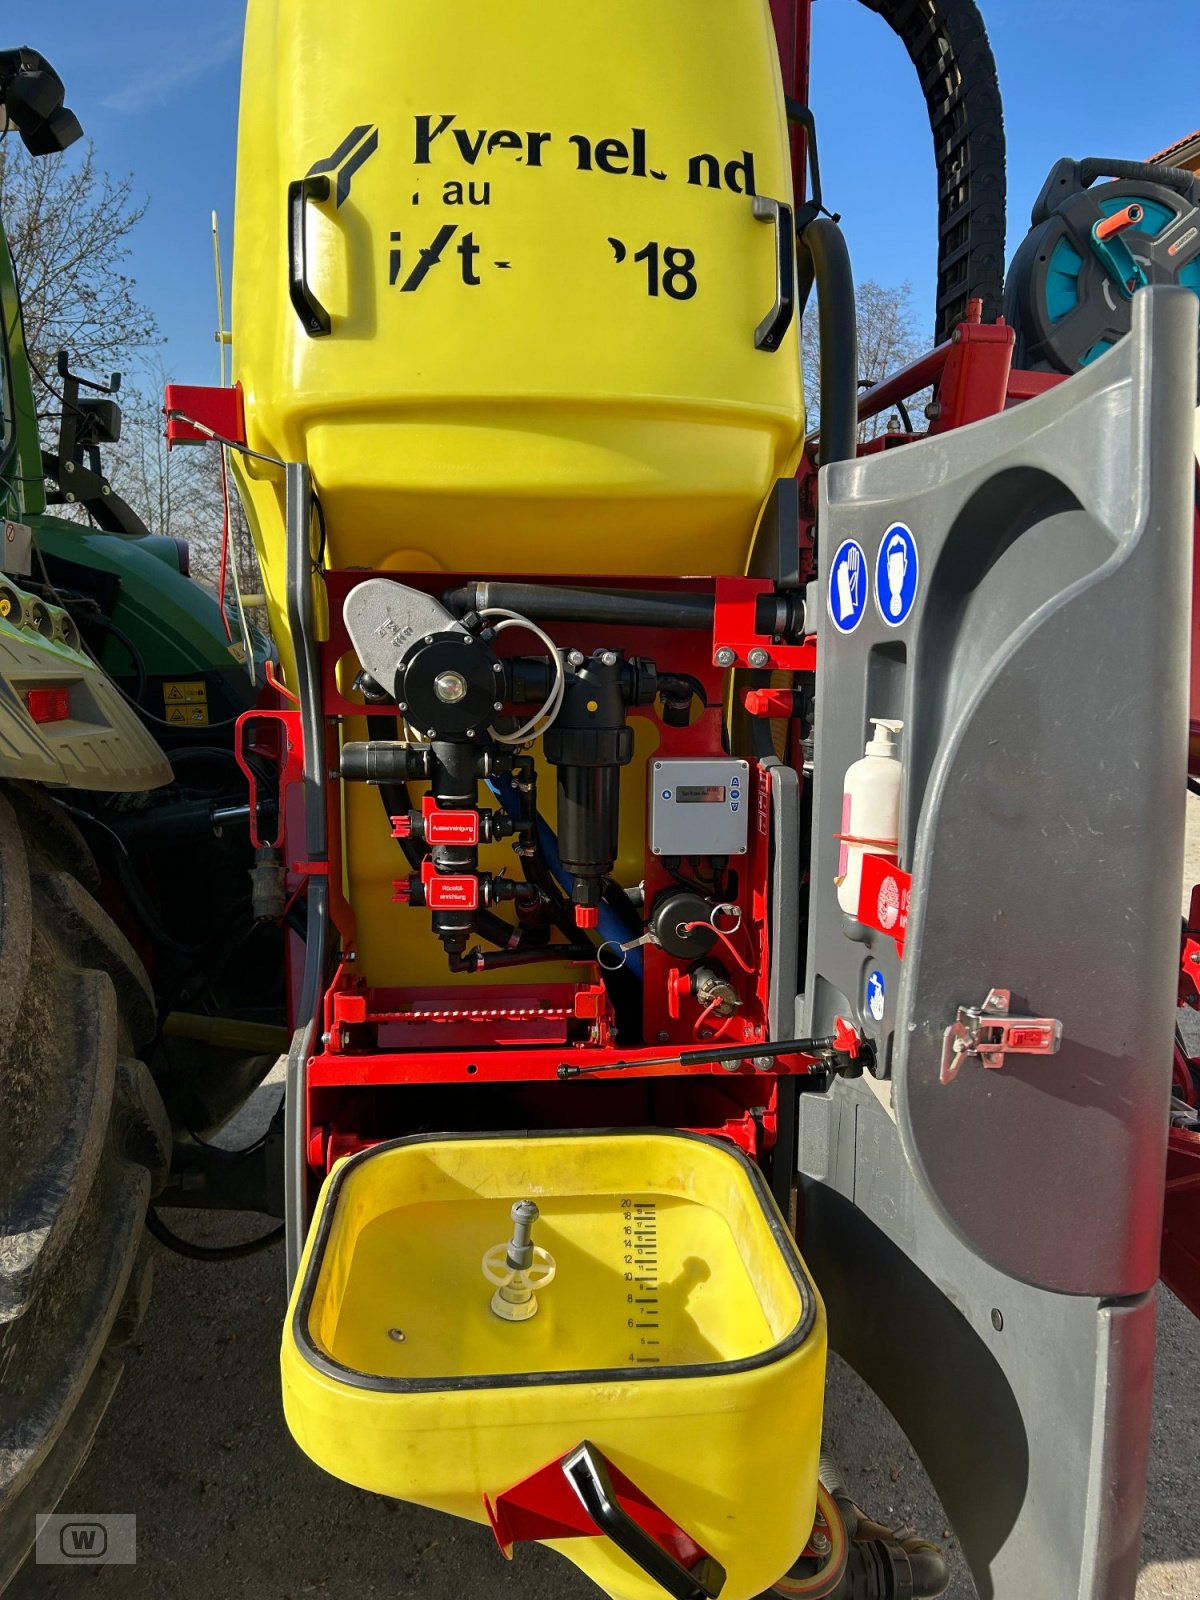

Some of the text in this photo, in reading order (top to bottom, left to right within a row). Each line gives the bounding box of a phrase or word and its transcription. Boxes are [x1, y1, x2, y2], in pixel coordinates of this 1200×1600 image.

[412, 114, 756, 198] Kvernelnd
[411, 178, 491, 206] au
[620, 1199, 632, 1208] 20
[623, 1212, 632, 1221] 18
[623, 1226, 632, 1235] 16
[623, 1239, 632, 1248] 14
[624, 1255, 633, 1264] 12
[624, 1272, 633, 1281] 10
[627, 1294, 633, 1303] 8
[627, 1318, 634, 1327] 6
[628, 1353, 634, 1362] 4
